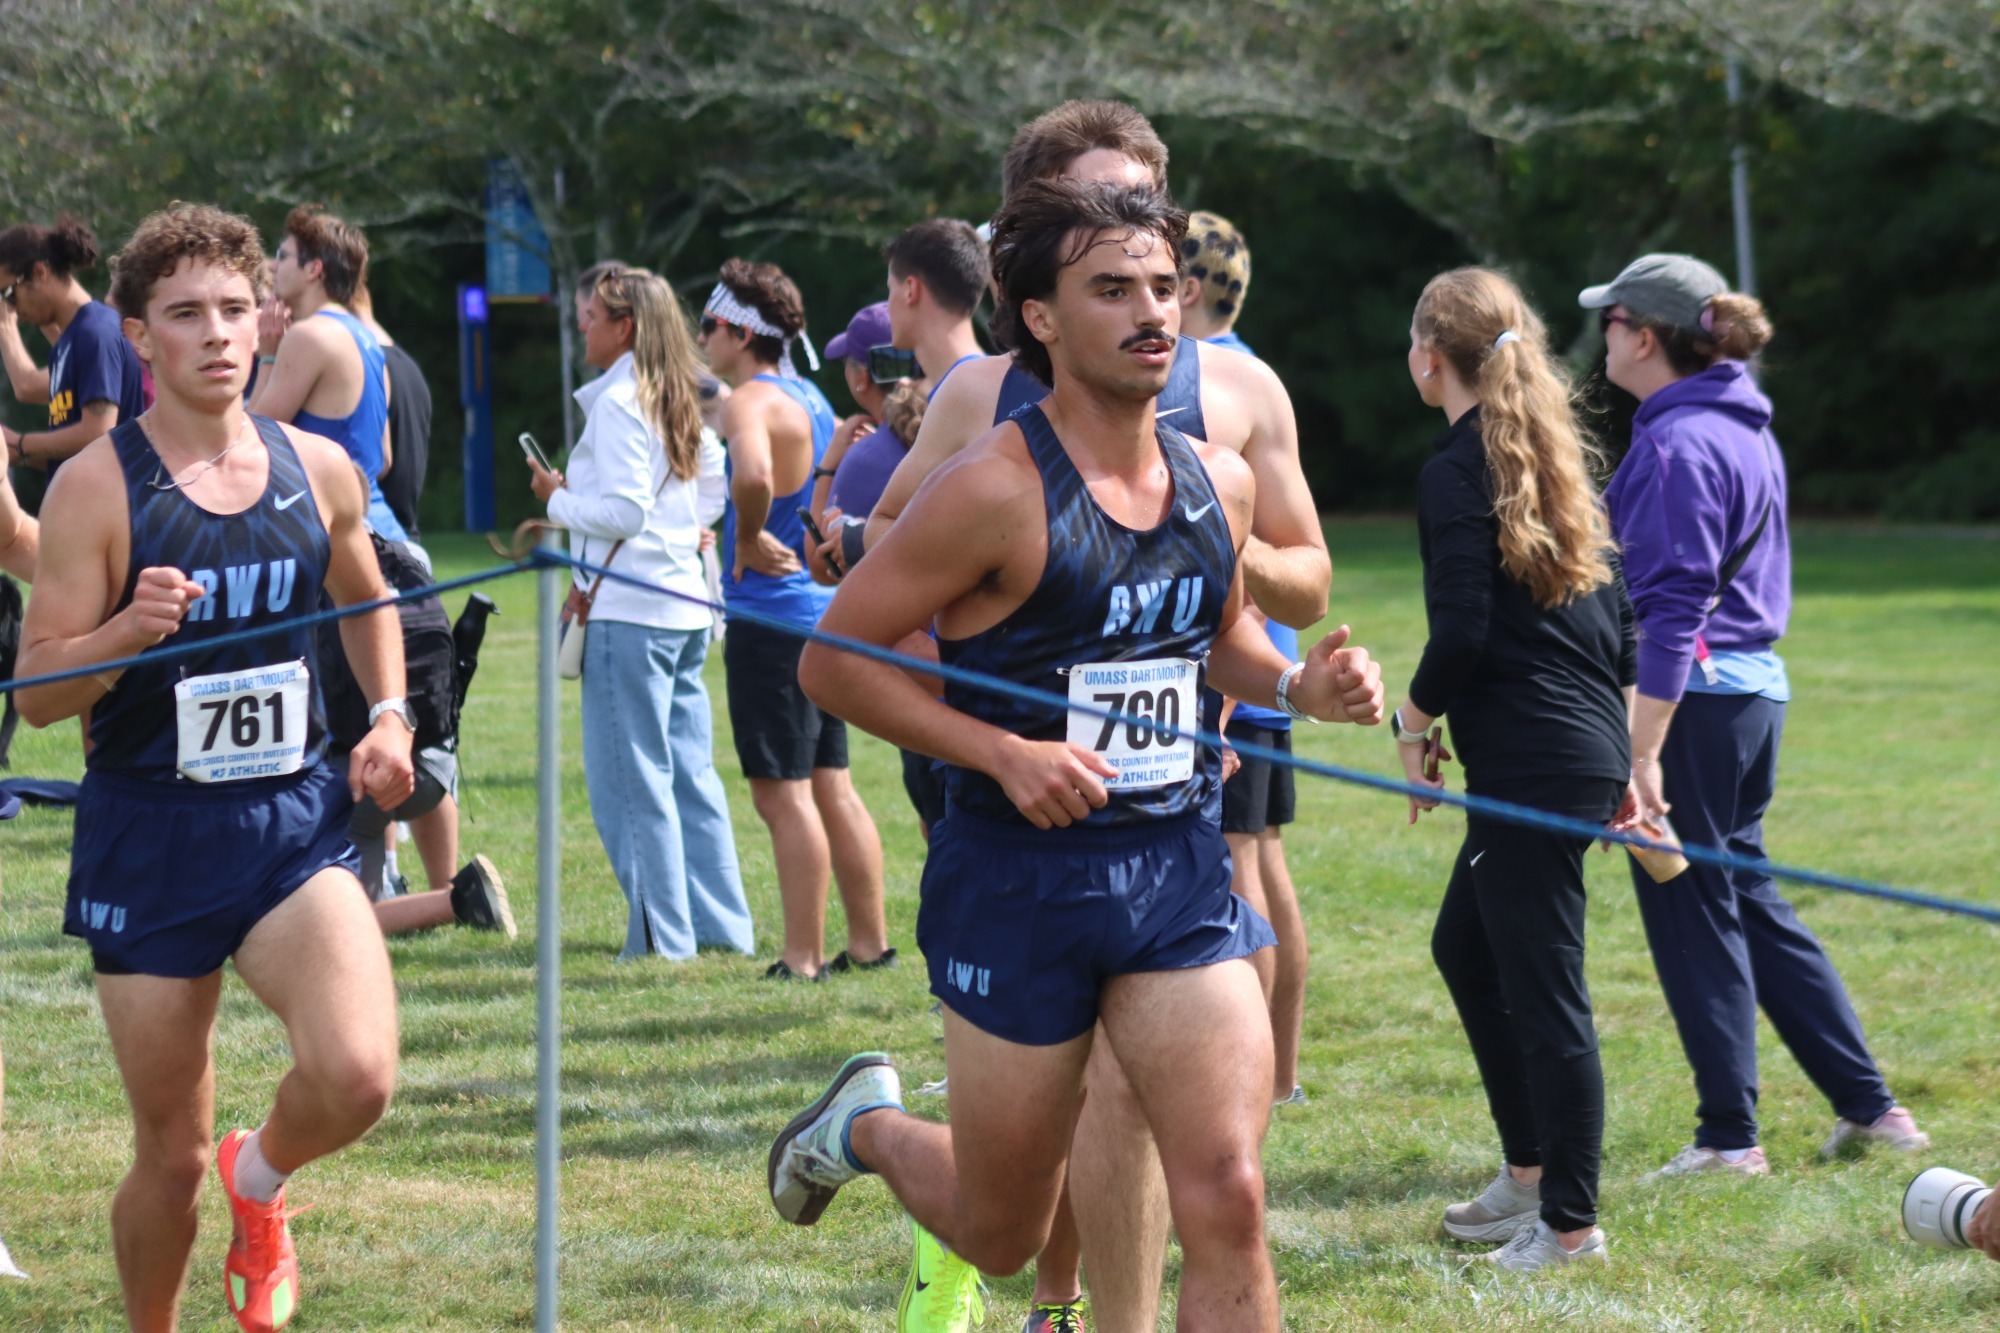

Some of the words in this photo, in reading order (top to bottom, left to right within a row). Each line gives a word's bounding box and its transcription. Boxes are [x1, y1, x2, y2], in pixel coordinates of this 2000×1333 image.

[187, 558, 296, 622] RWU
[1102, 576, 1203, 638] RWU
[190, 681, 230, 697] UMASS
[234, 669, 297, 691] DARTMOUTH
[1085, 670, 1127, 685] UMASS
[1131, 664, 1186, 683] DARTMOUTH
[199, 691, 284, 752] 761
[1093, 687, 1179, 751] 760
[227, 752, 260, 762] COUNTRY
[1121, 756, 1152, 767] COUNTRY
[1154, 751, 1189, 764] INVITATIONAL
[227, 762, 280, 777] ATHLETIC
[1121, 769, 1169, 784] ATHLETIC
